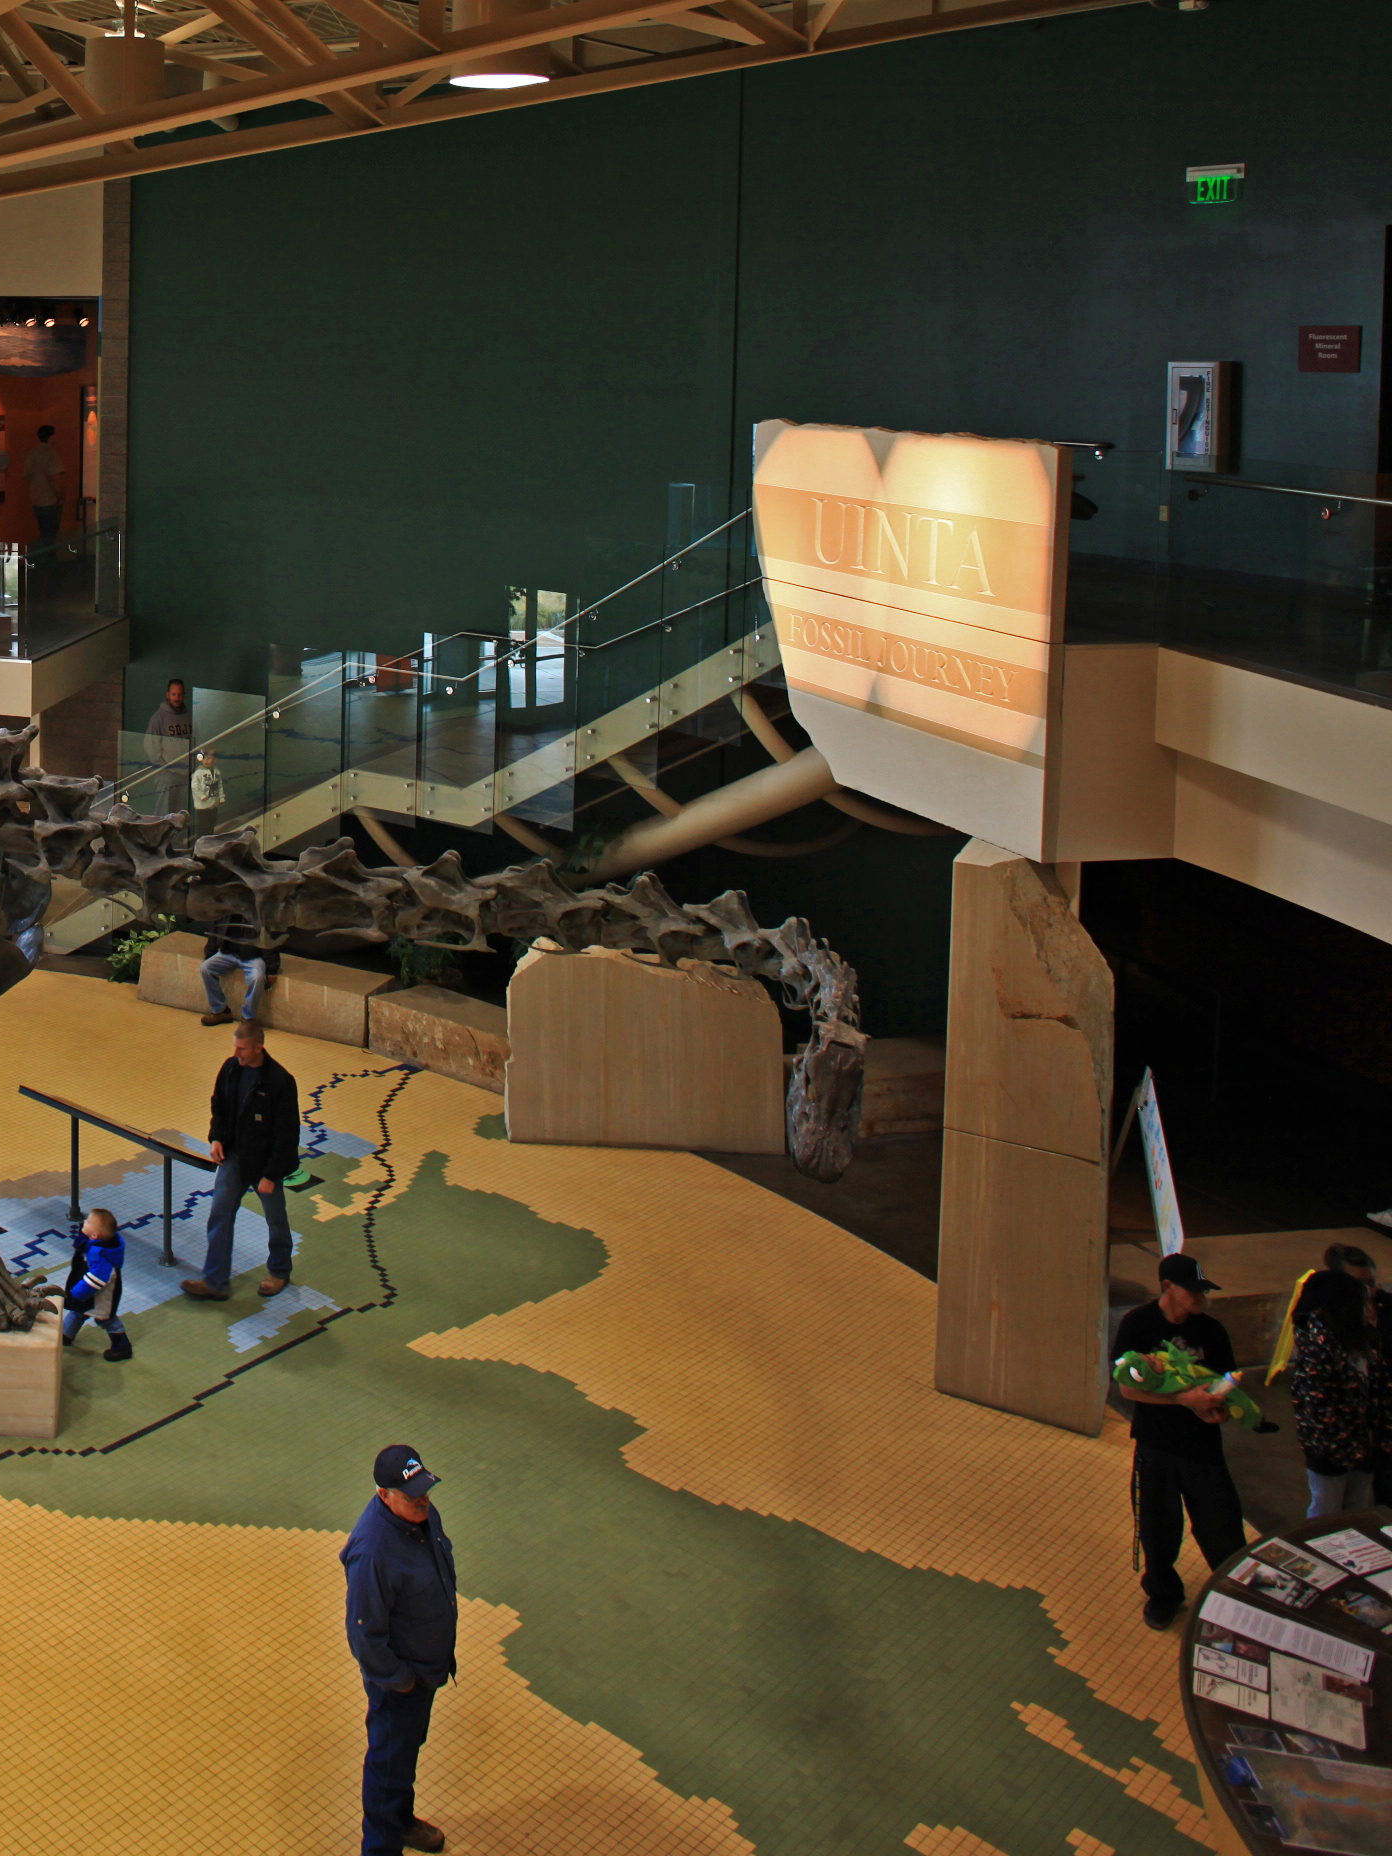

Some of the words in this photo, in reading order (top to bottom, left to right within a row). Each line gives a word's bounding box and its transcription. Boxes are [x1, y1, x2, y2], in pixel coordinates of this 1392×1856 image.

[1197, 176, 1231, 201] EXIT
[812, 497, 996, 597] UINTA
[788, 613, 870, 663] FOSSIL
[876, 636, 1018, 703] JOURNEY
